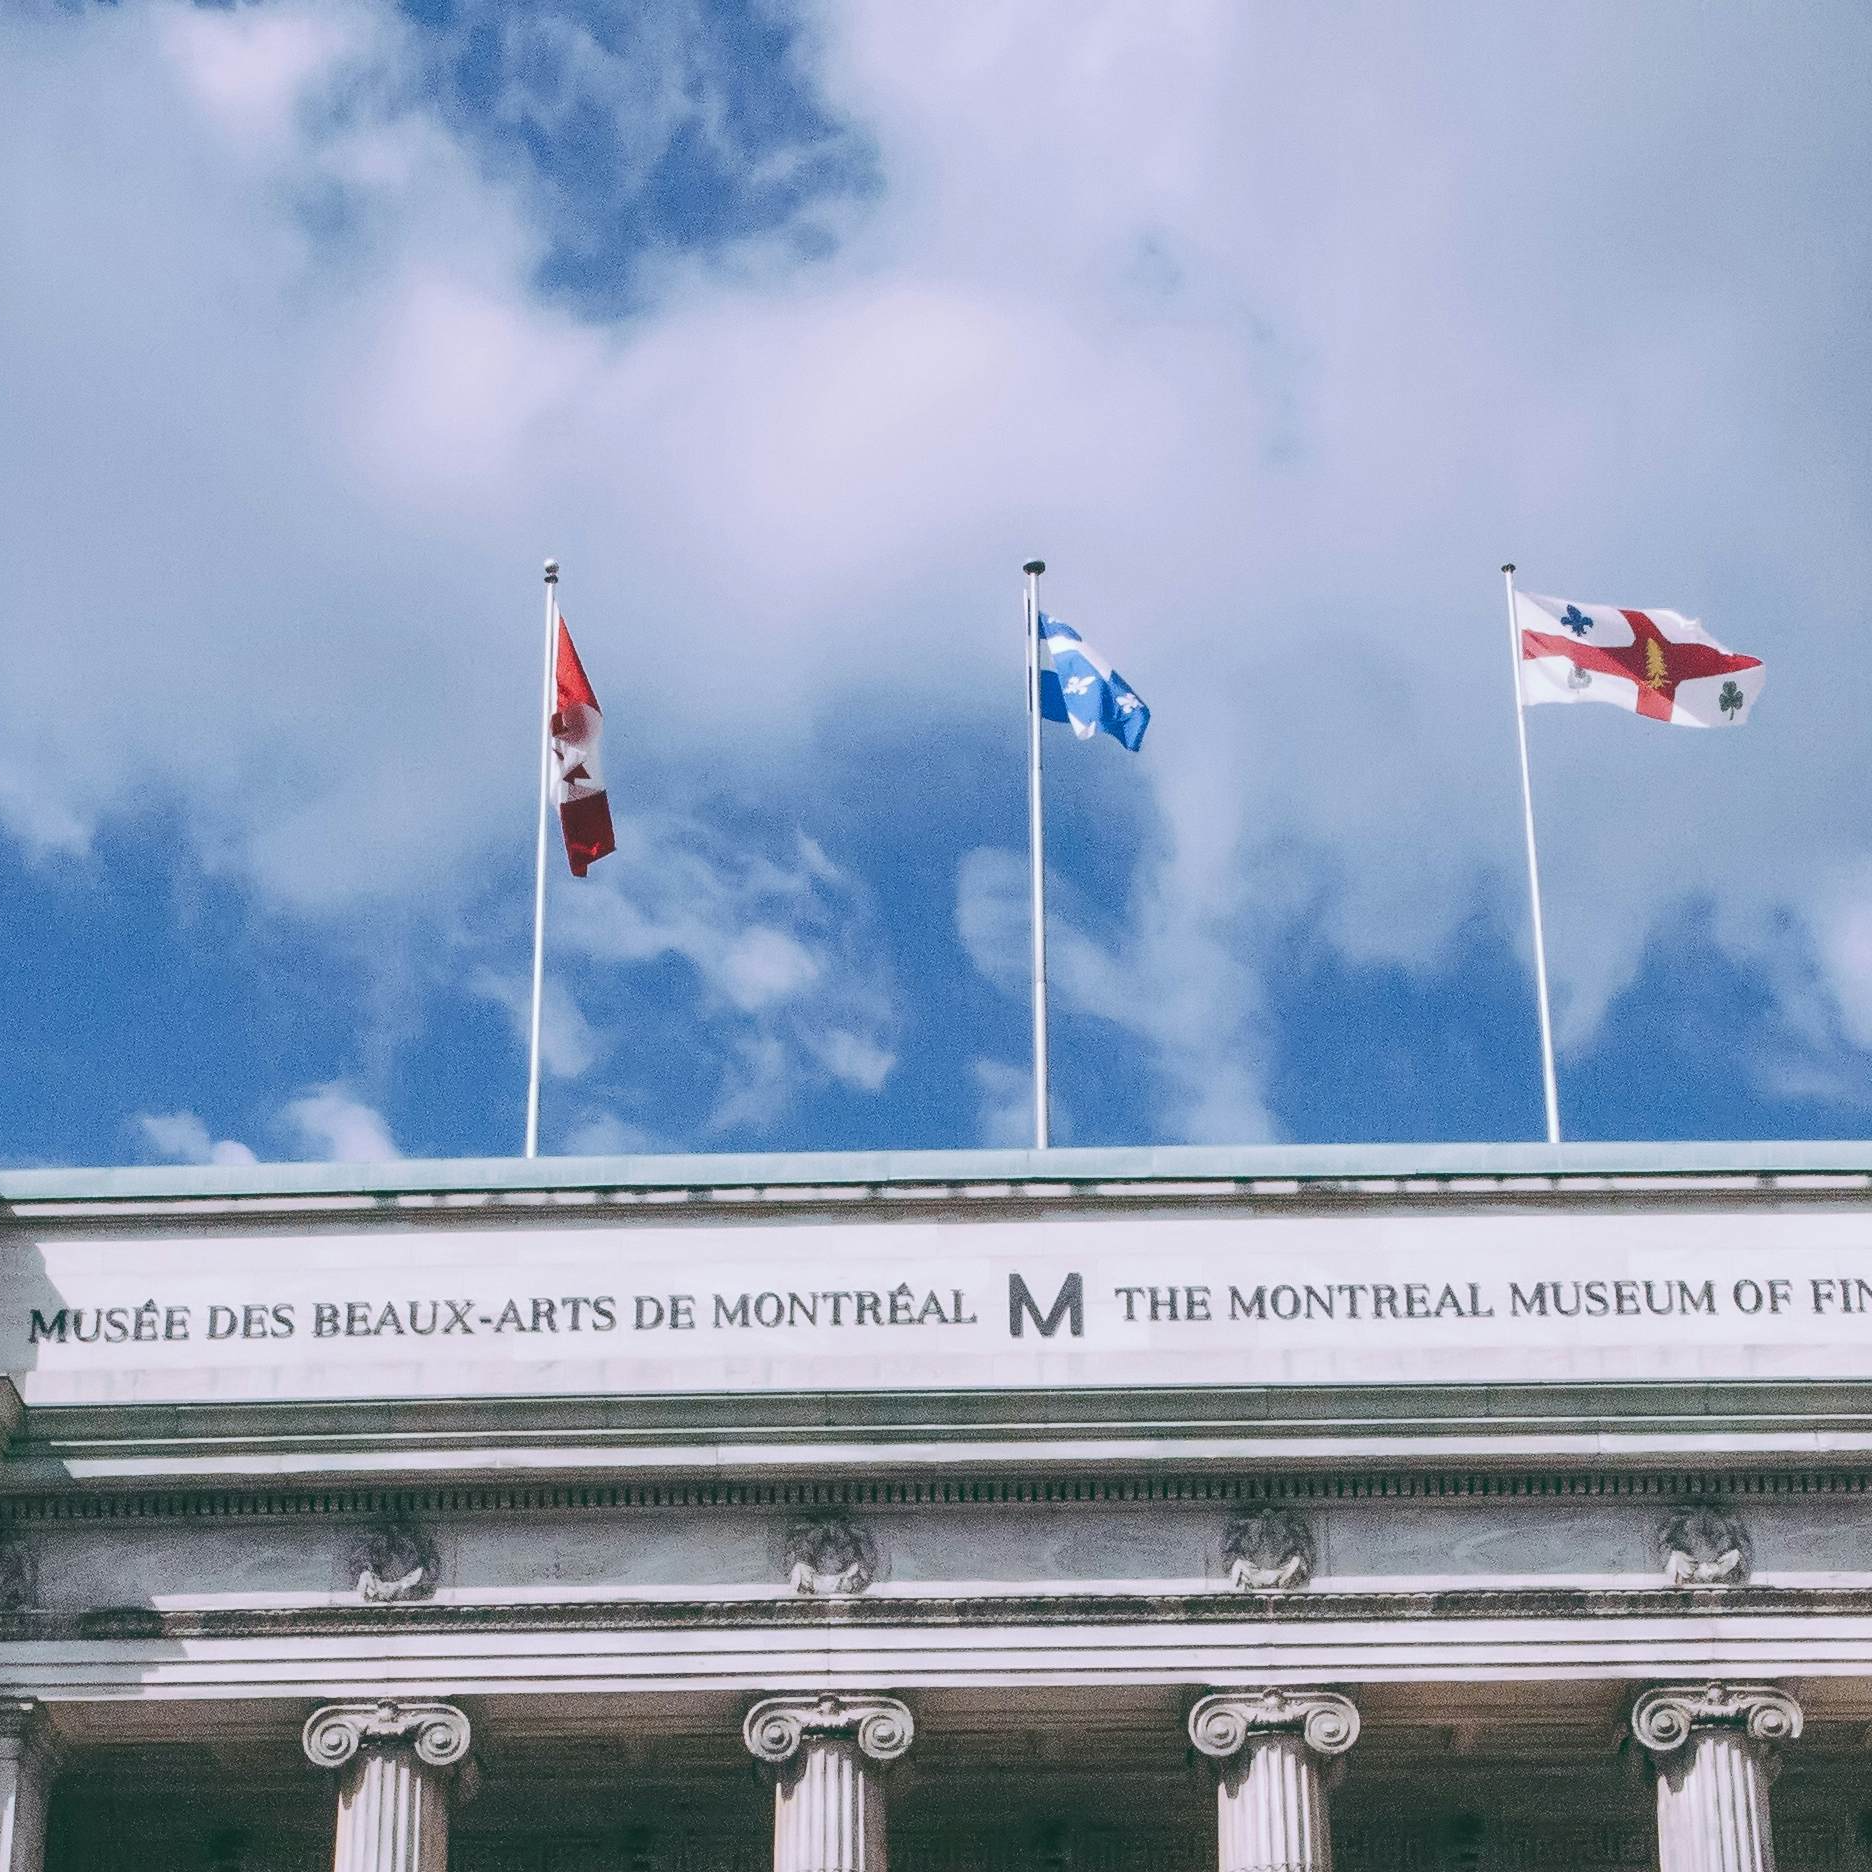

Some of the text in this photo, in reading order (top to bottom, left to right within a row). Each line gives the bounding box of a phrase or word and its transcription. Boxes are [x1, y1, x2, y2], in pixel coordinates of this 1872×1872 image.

[28, 1282, 978, 1343] MUSÉE DES BEAUX-ARTS DE MONTRÉAL
[1007, 1272, 1085, 1338] M
[1114, 1286, 1213, 1321] THE
[1227, 1282, 1495, 1320] MONTREAL
[1507, 1280, 1720, 1317] MUSEUM
[1732, 1279, 1794, 1315] OF
